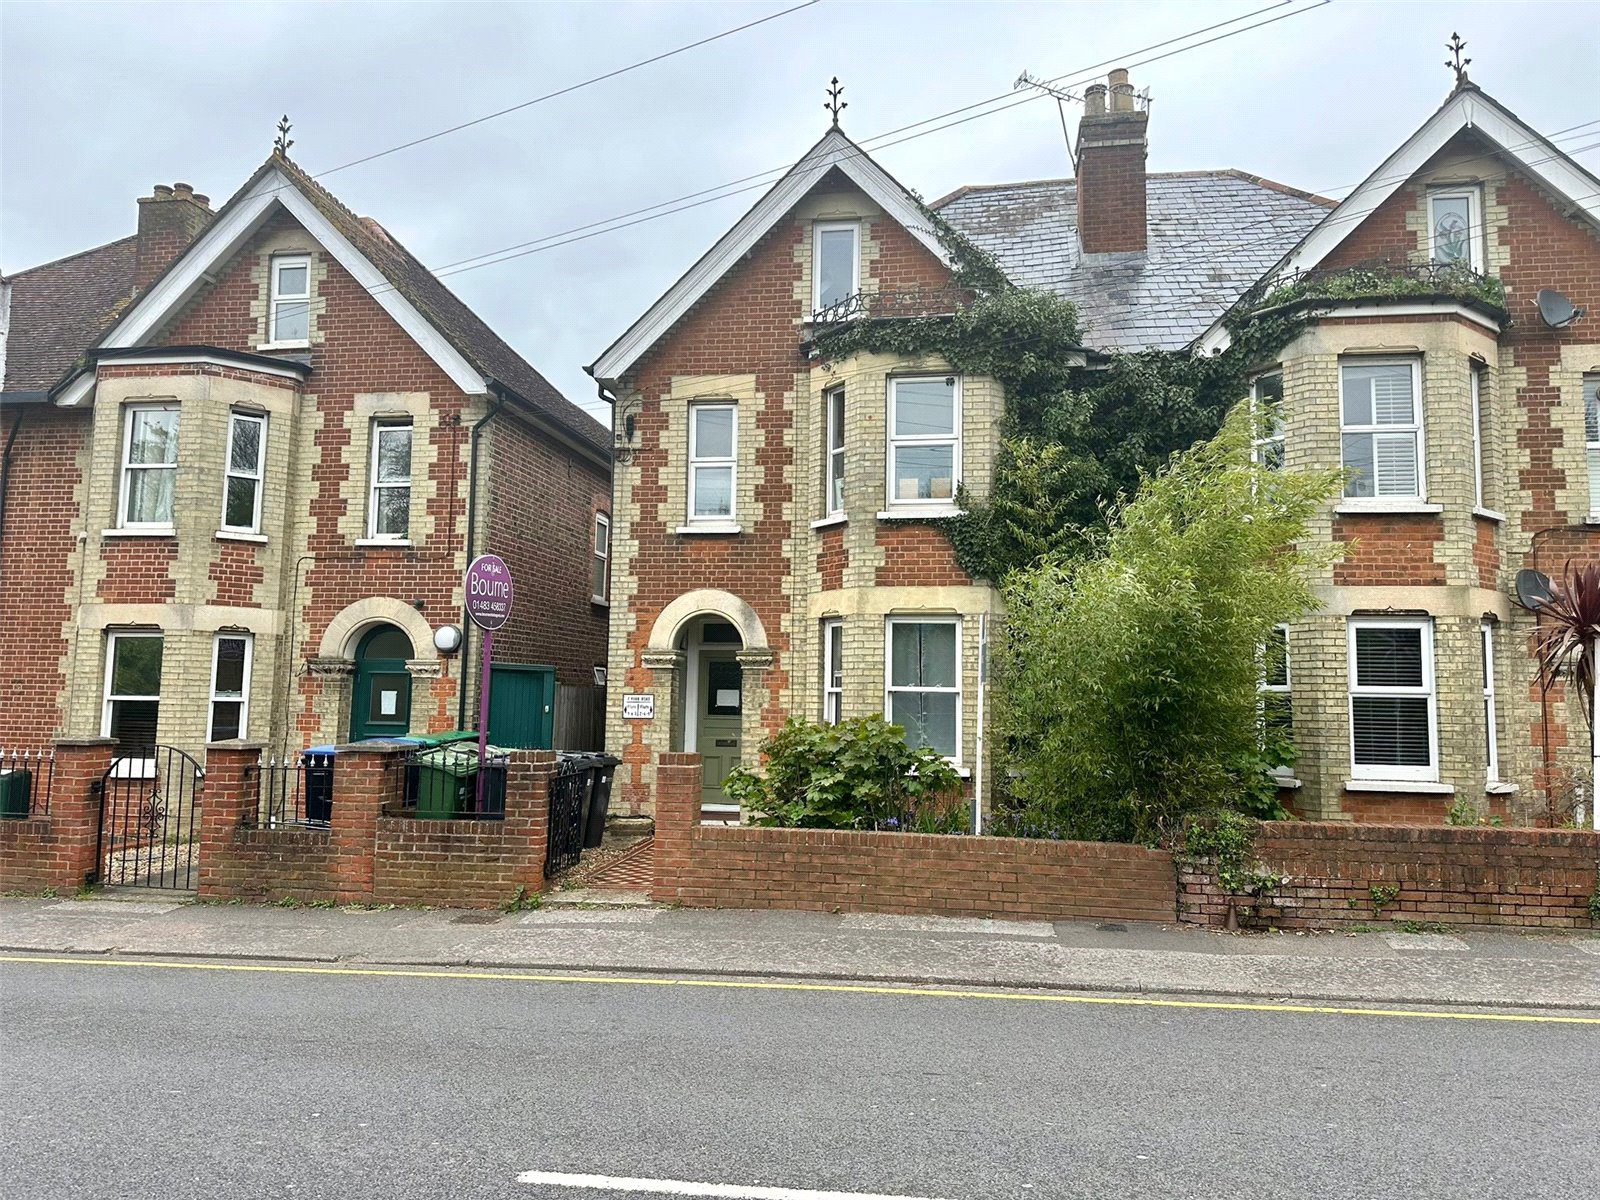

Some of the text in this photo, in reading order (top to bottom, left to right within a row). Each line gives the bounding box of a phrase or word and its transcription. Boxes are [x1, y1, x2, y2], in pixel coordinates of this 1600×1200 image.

[481, 563, 502, 574] FOR SALE
[471, 572, 509, 599] Bourne
[473, 600, 490, 611] 01483
